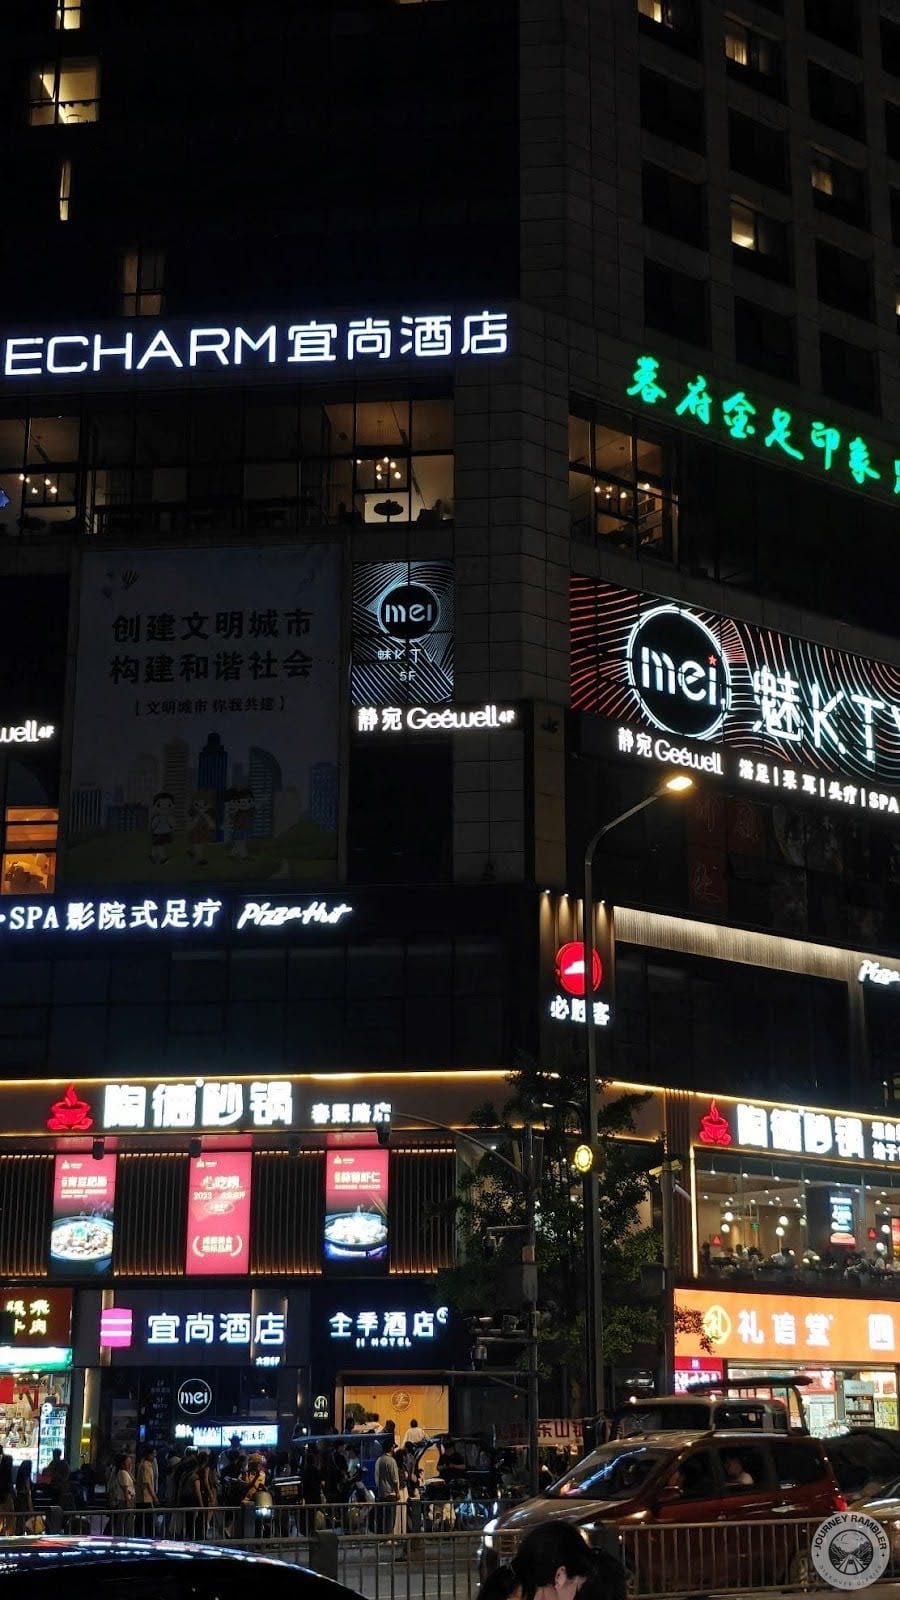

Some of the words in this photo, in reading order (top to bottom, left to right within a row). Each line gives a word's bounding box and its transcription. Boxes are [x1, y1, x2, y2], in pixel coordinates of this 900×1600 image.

[5, 325, 277, 376] ECHARM
[287, 310, 508, 363] 宜尚酒店
[627, 356, 900, 494] 蓉府金足印象
[111, 608, 314, 643] 创建文明城市
[385, 603, 433, 623] mei
[109, 649, 313, 684] 构建和谐社会
[400, 671, 416, 682] 5F
[641, 646, 717, 706] mei
[66, 898, 223, 931] 影院式足疗
[237, 903, 302, 929] Pizza
[302, 901, 352, 924] Hut
[148, 1312, 286, 1345] 宜尚酒店
[329, 1311, 434, 1337] 全季酒店
[737, 1309, 831, 1347] 礼信堂
[371, 1337, 412, 1348] HOTEL
[180, 1388, 208, 1404] mei
